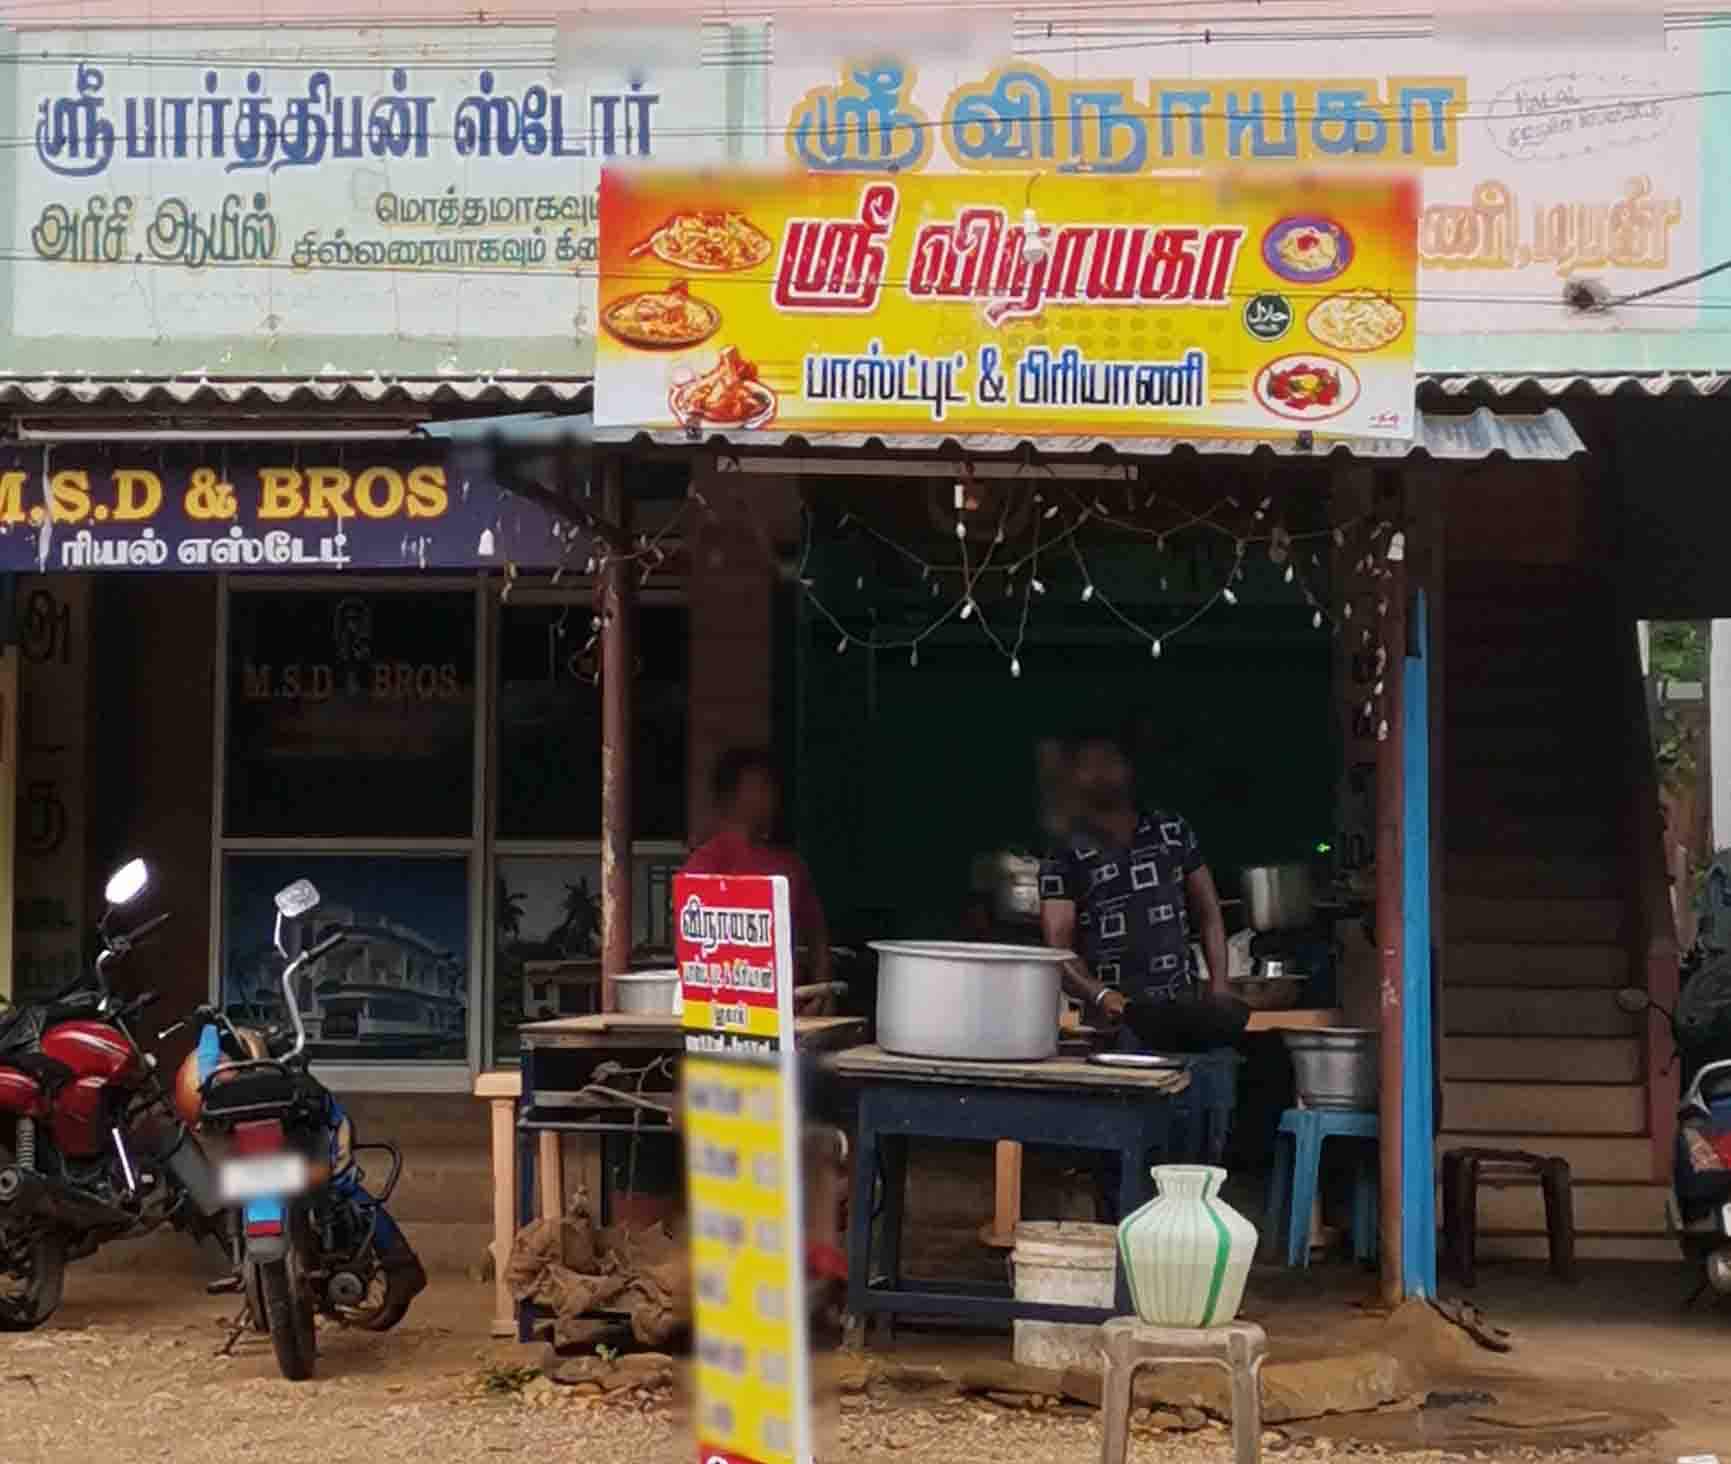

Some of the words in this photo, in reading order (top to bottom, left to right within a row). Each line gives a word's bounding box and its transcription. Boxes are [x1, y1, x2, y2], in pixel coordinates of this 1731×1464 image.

[125, 67, 436, 174] பார்த்திபன்
[454, 68, 659, 158] ஸ்டோர்
[950, 70, 1457, 174] விநாயகா
[907, 205, 1244, 325] விநாயகா
[977, 345, 1006, 403] &
[1016, 348, 1207, 408] பிரியாணி
[185, 466, 239, 520] &
[258, 465, 449, 519] BROS
[62, 527, 169, 566] ரியல்
[177, 525, 351, 564] எஸ்டேட்
